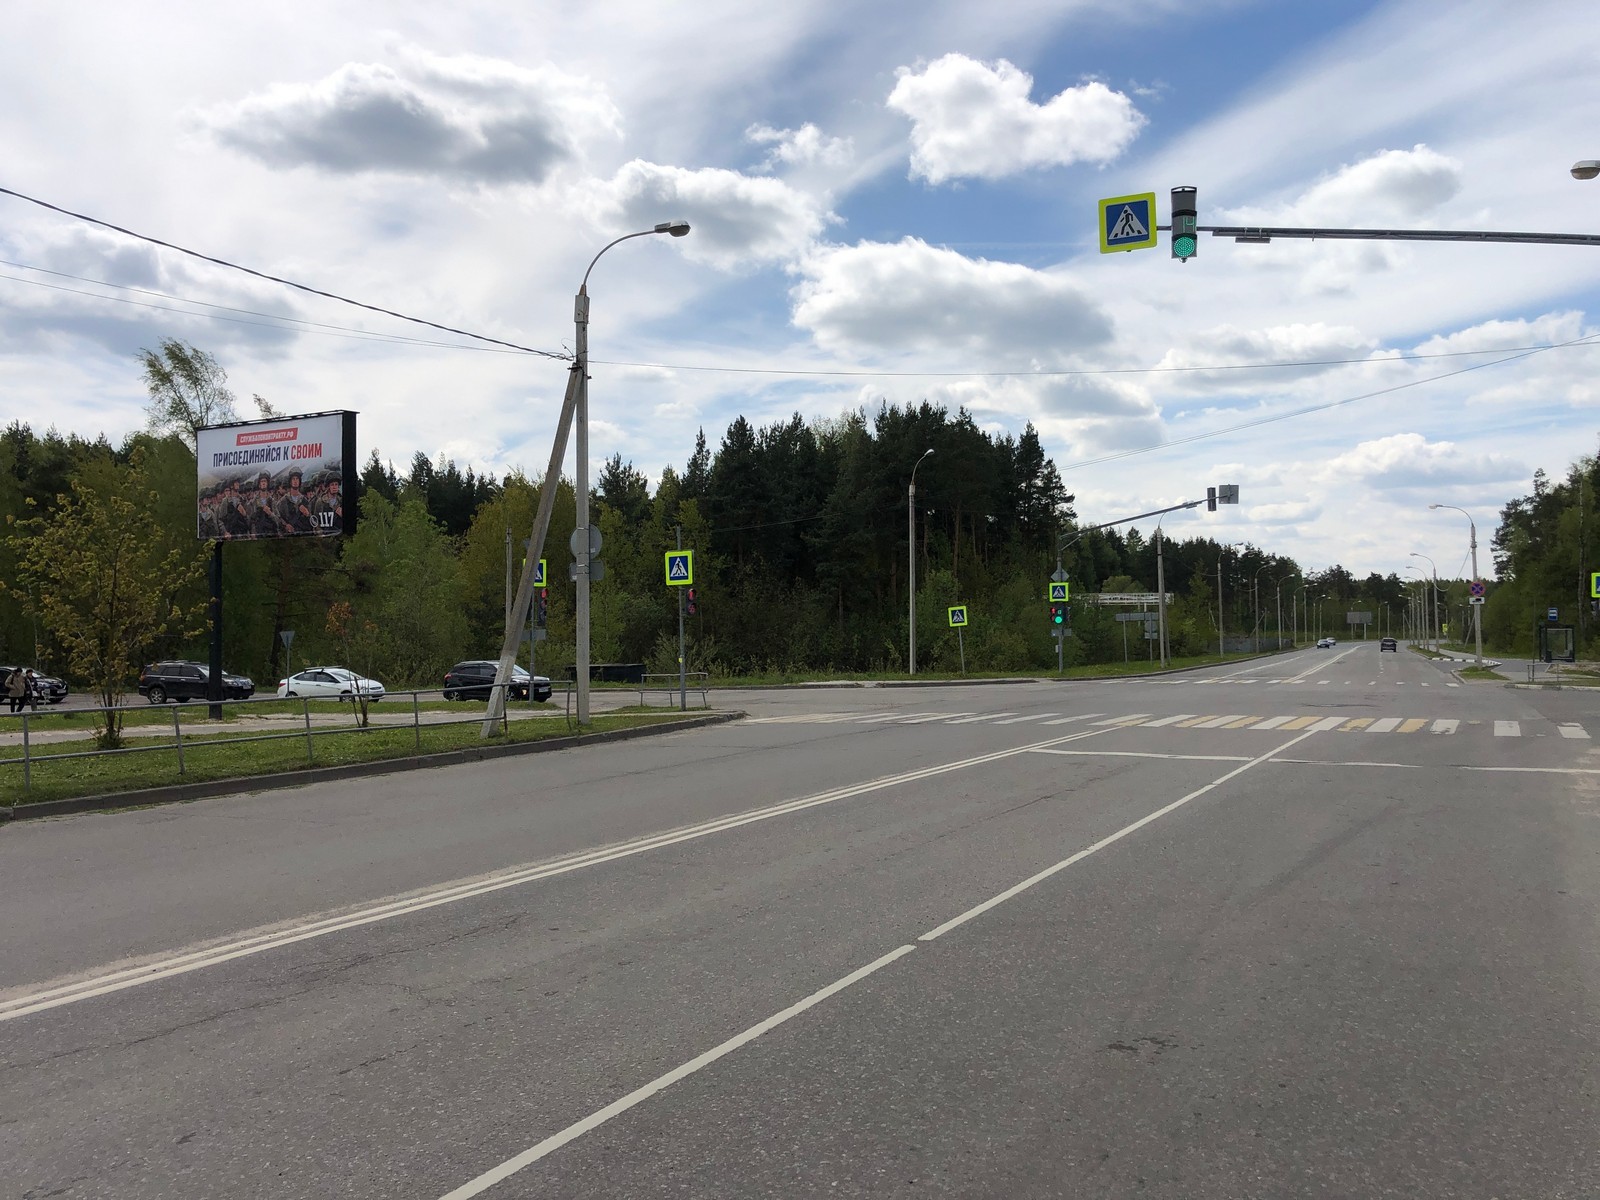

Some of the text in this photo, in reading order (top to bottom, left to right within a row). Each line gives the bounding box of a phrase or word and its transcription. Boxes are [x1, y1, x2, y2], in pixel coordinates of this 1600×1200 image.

[213, 443, 322, 467] ПРИСОЕДИНЯЙСЯ К СВОИМ
[319, 512, 334, 527] 117
